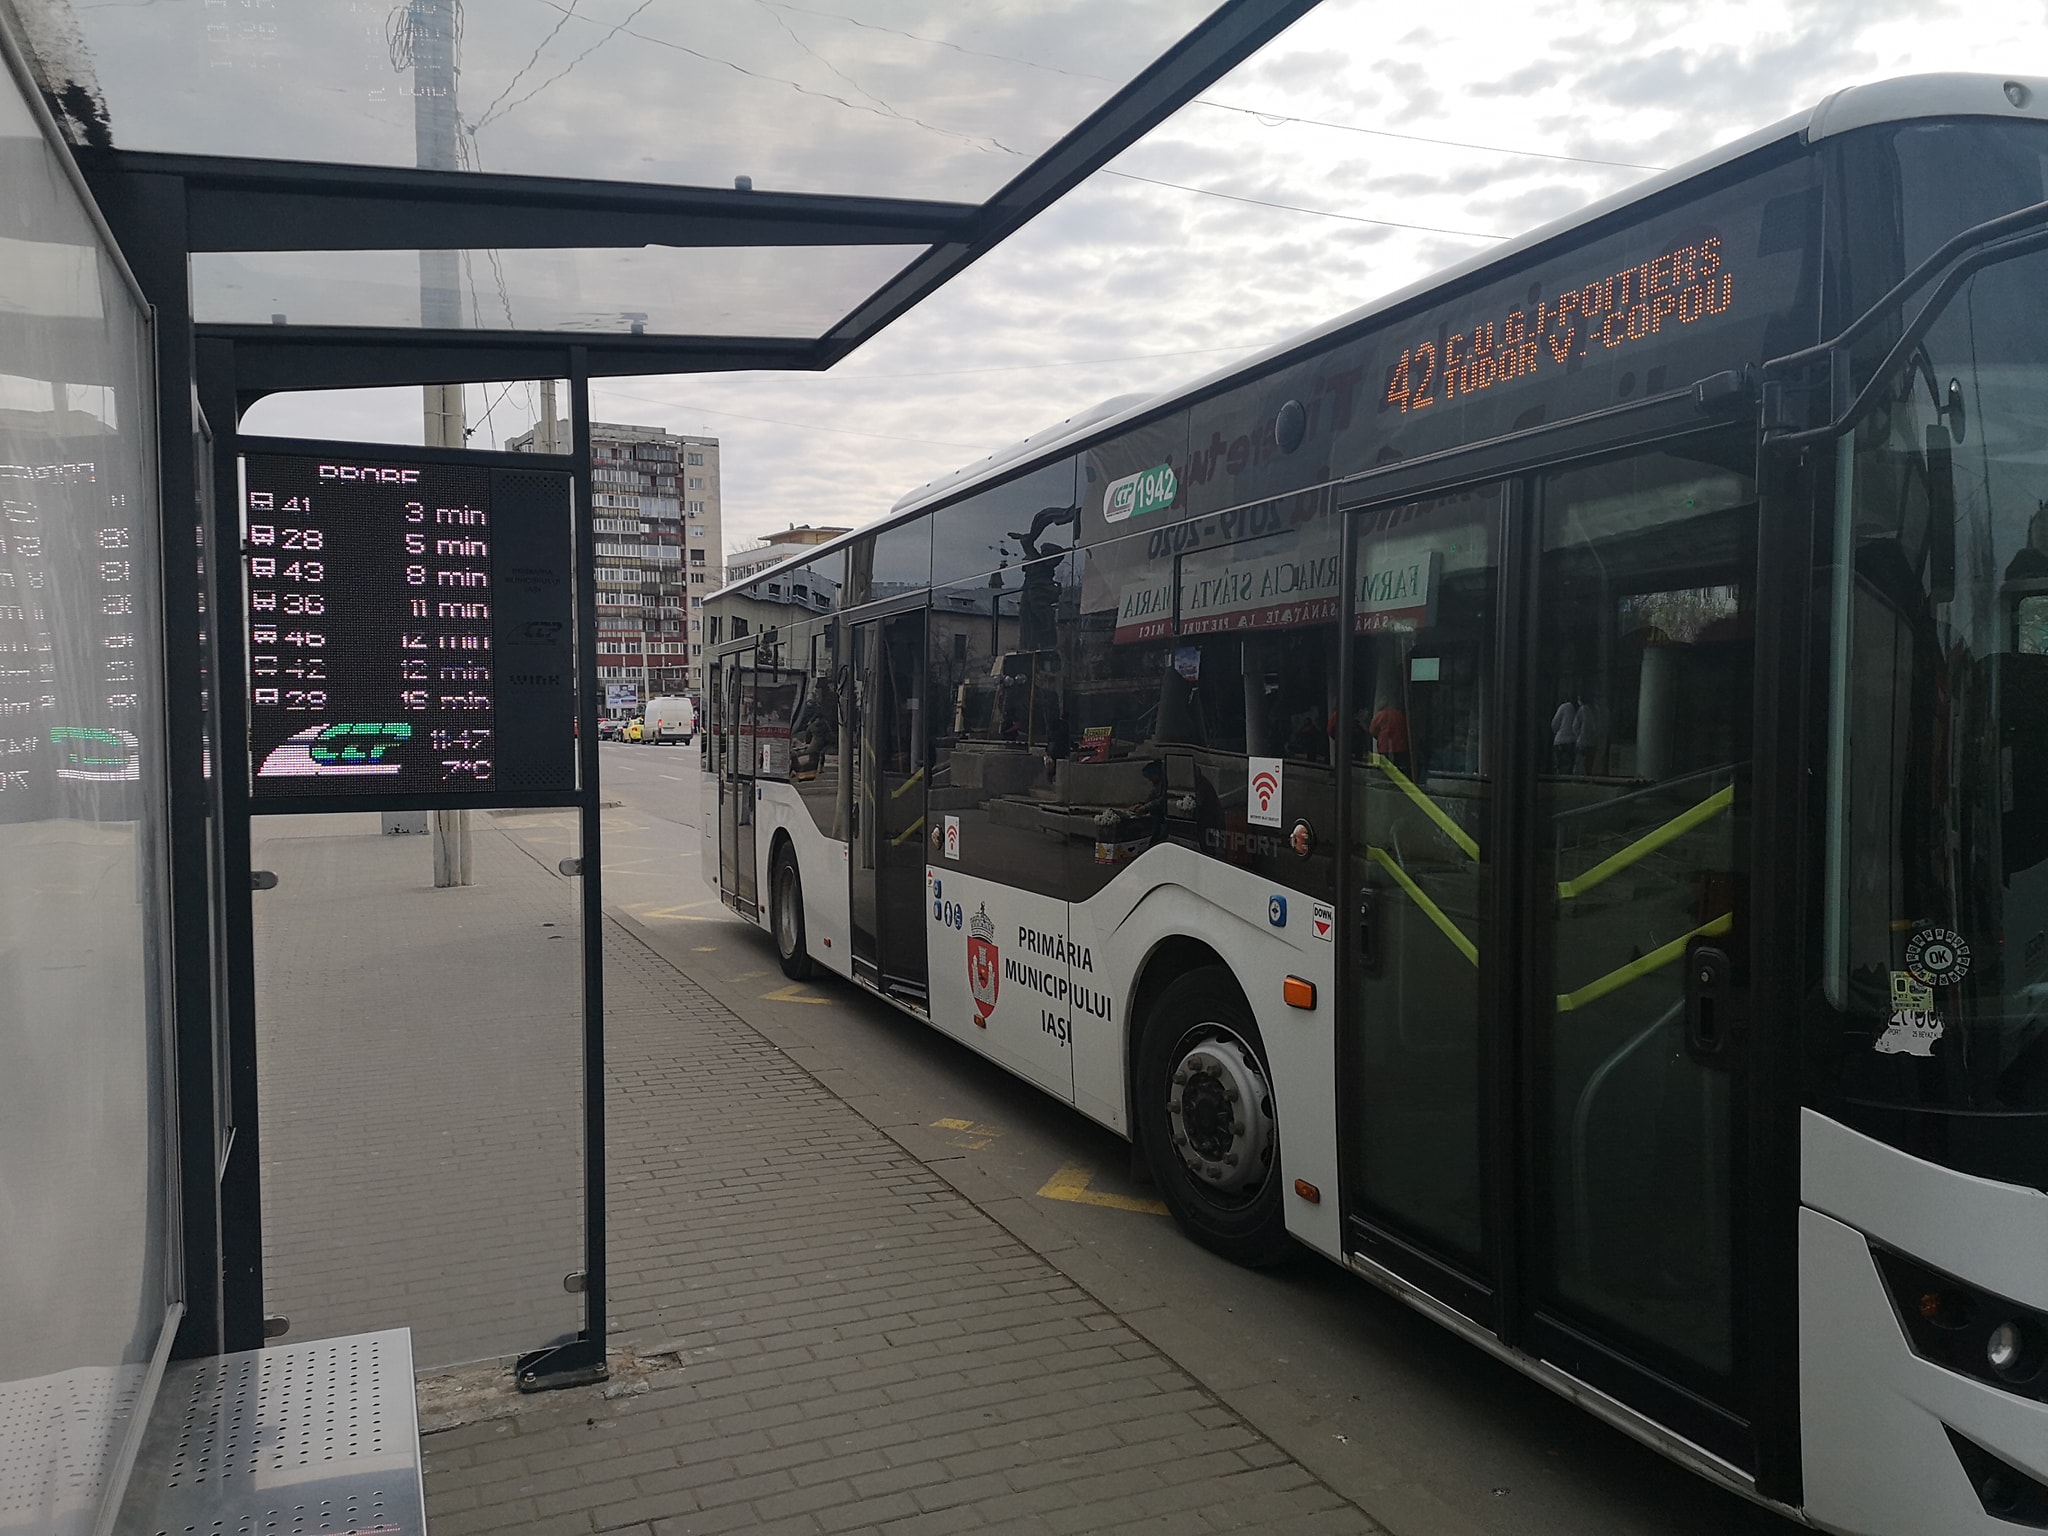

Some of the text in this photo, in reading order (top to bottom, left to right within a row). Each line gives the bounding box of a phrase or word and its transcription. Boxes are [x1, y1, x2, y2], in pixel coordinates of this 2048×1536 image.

[1387, 341, 1435, 413] 42
[1443, 341, 1538, 399] TUDOR
[1137, 467, 1175, 508] 1942
[281, 496, 487, 525] 41 3 min
[282, 528, 487, 556] 28 5 min
[283, 561, 324, 582] 43
[406, 565, 425, 585] 8
[438, 568, 487, 586] min
[283, 595, 488, 618] 36 11 min
[440, 660, 489, 680] min
[440, 690, 489, 710] min
[1314, 906, 1332, 921] DOWN
[1018, 925, 1094, 974] PRIMĂRIA
[1929, 950, 1949, 965] OK
[1004, 957, 1112, 1022] MUNICIPIULUI
